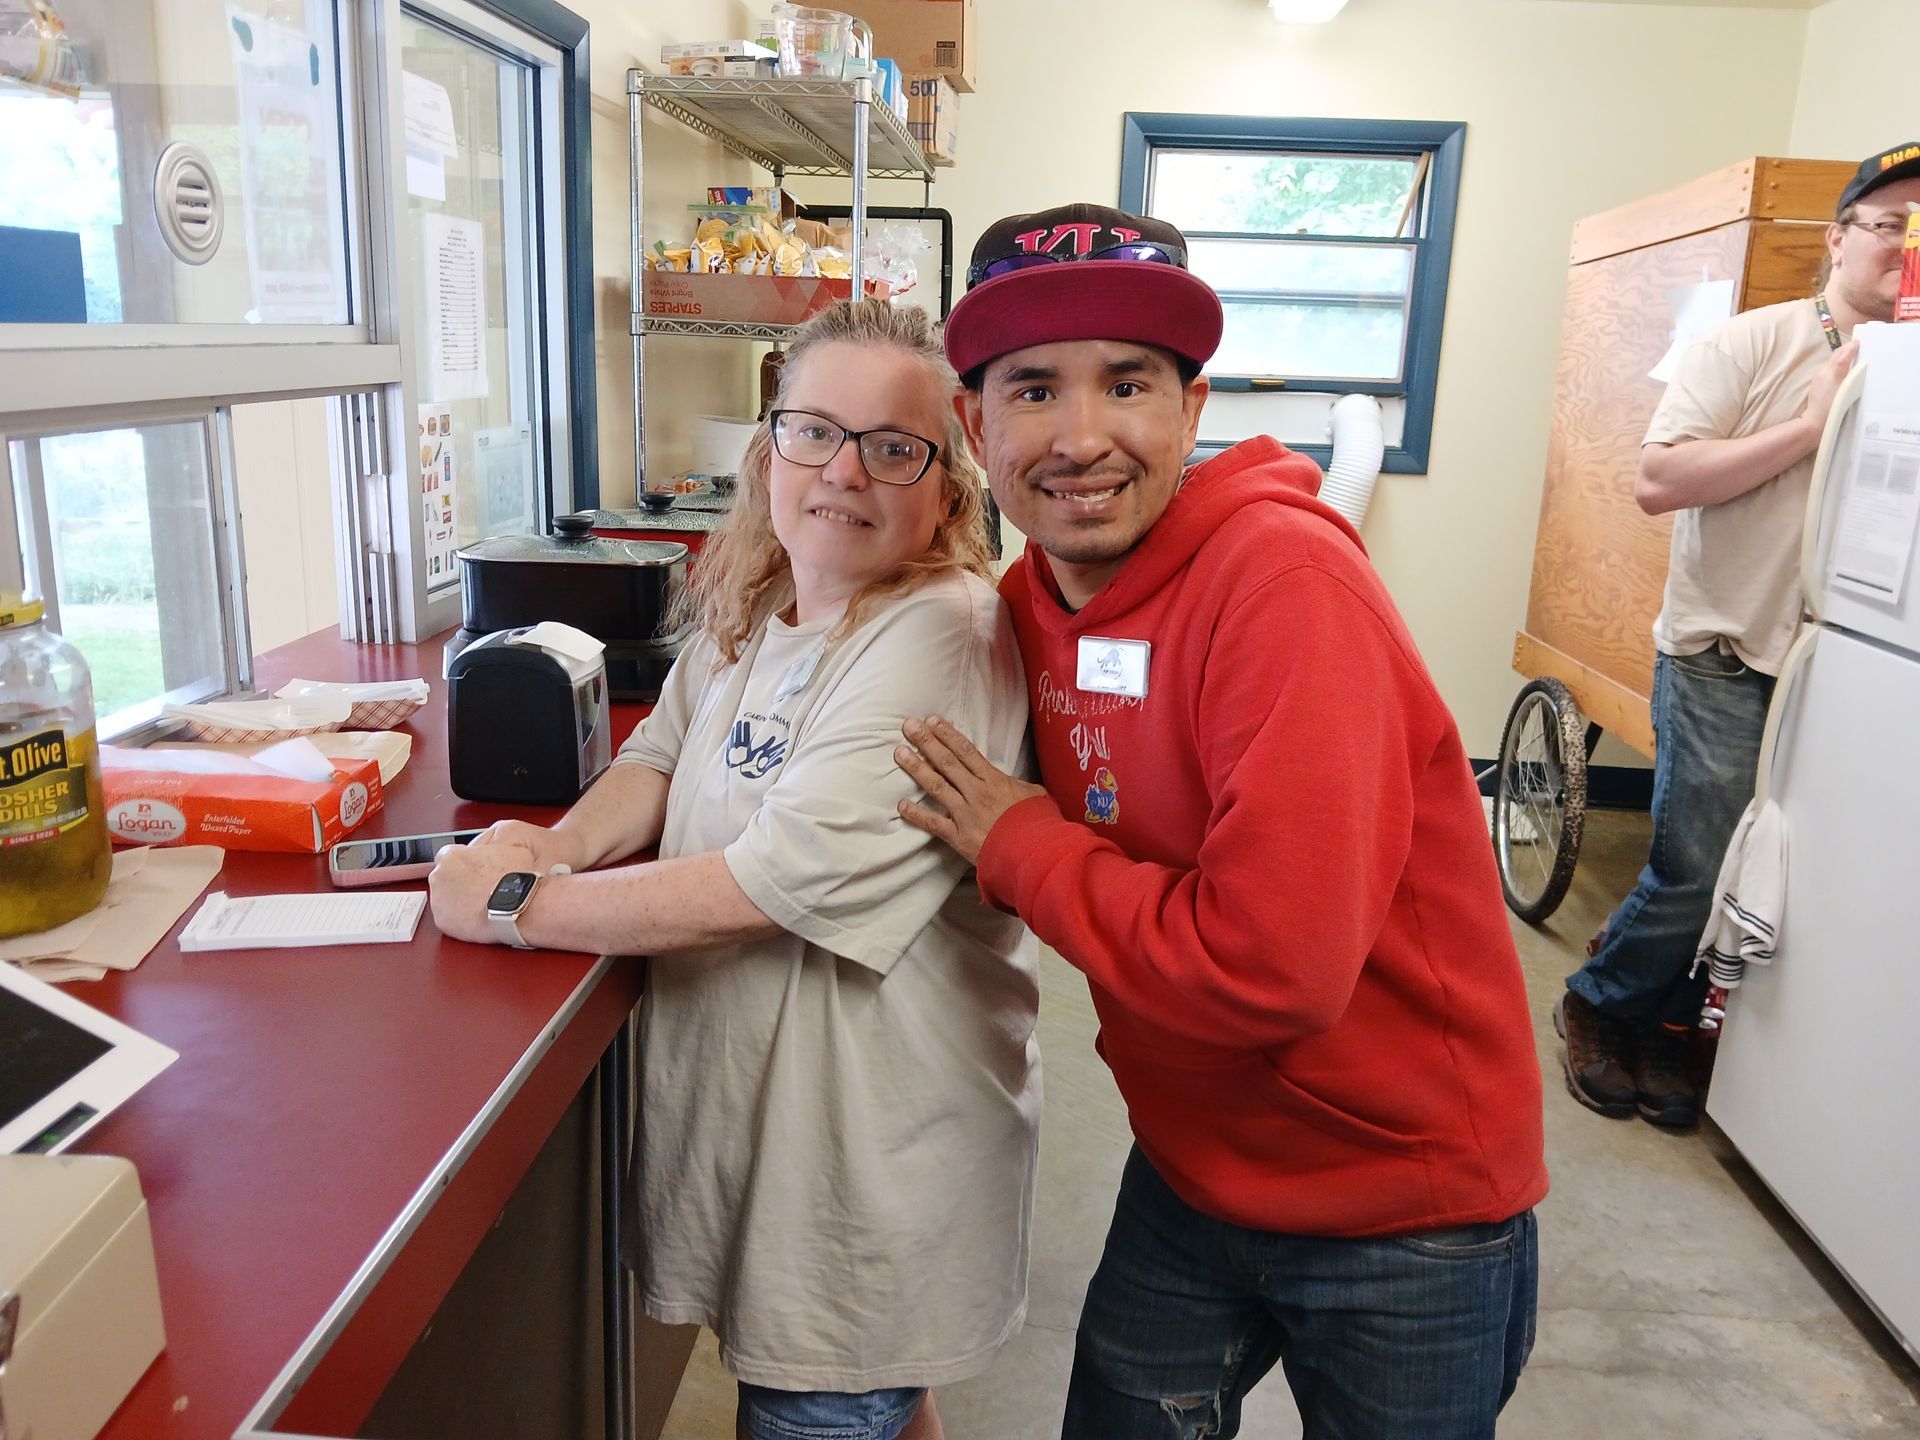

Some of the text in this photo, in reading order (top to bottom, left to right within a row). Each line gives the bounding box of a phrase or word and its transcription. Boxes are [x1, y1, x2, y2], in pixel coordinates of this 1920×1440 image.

[909, 80, 938, 97] 500
[650, 301, 702, 315] STAPLES
[12, 742, 62, 777] Olive
[0, 781, 70, 809] OSHER
[0, 799, 58, 823] DILLS
[343, 794, 366, 820] Logan
[117, 811, 177, 832] Logan
[228, 824, 253, 835] Paper
[9, 833, 35, 845] SINCE
